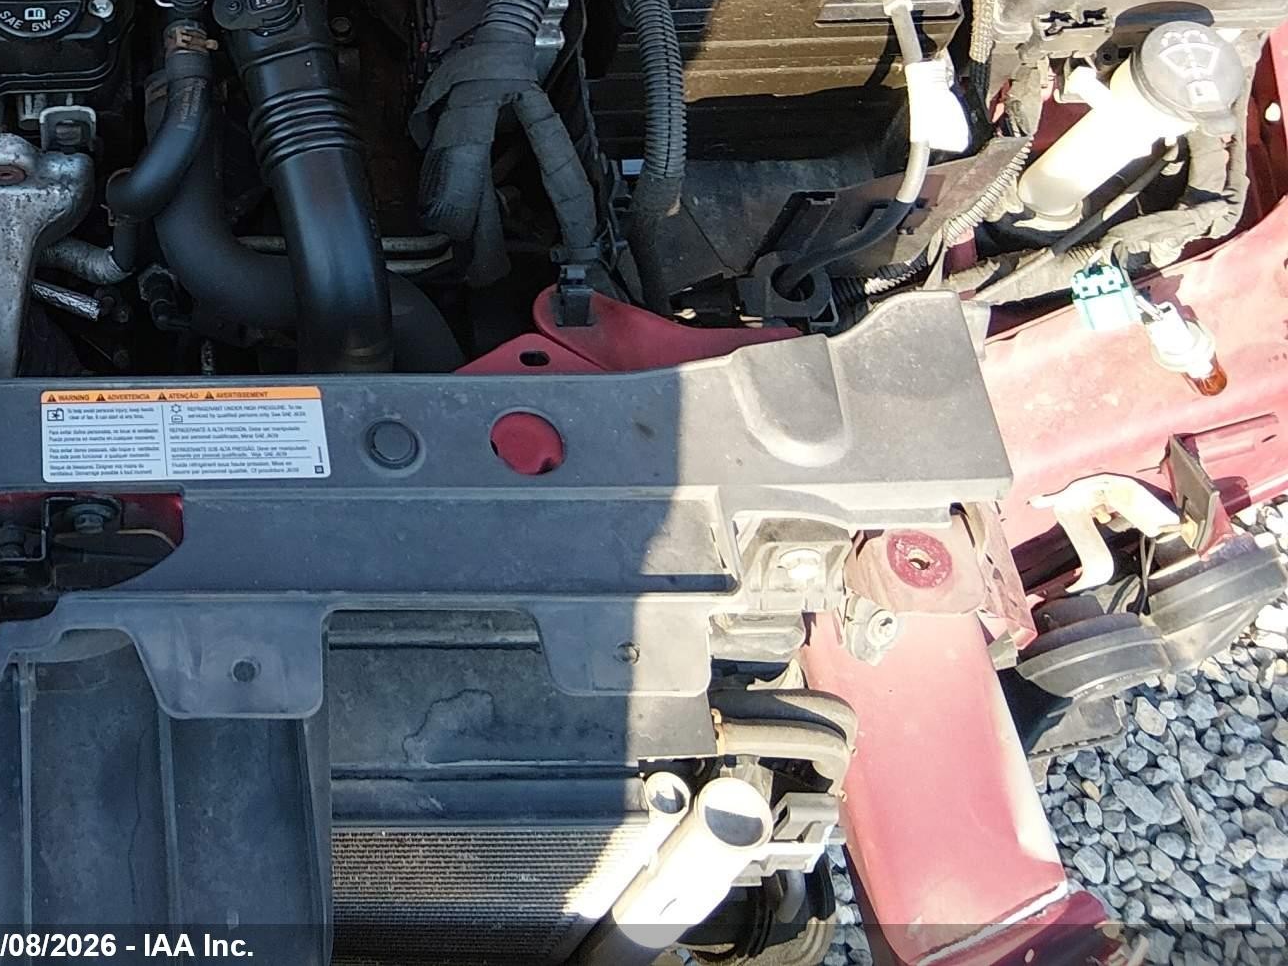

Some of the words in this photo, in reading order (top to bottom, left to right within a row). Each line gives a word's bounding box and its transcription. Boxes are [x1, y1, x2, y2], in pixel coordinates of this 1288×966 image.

[0, 10, 24, 30] SAE
[32, 9, 71, 32] 5W-30
[168, 391, 198, 400] ATENÇÃO
